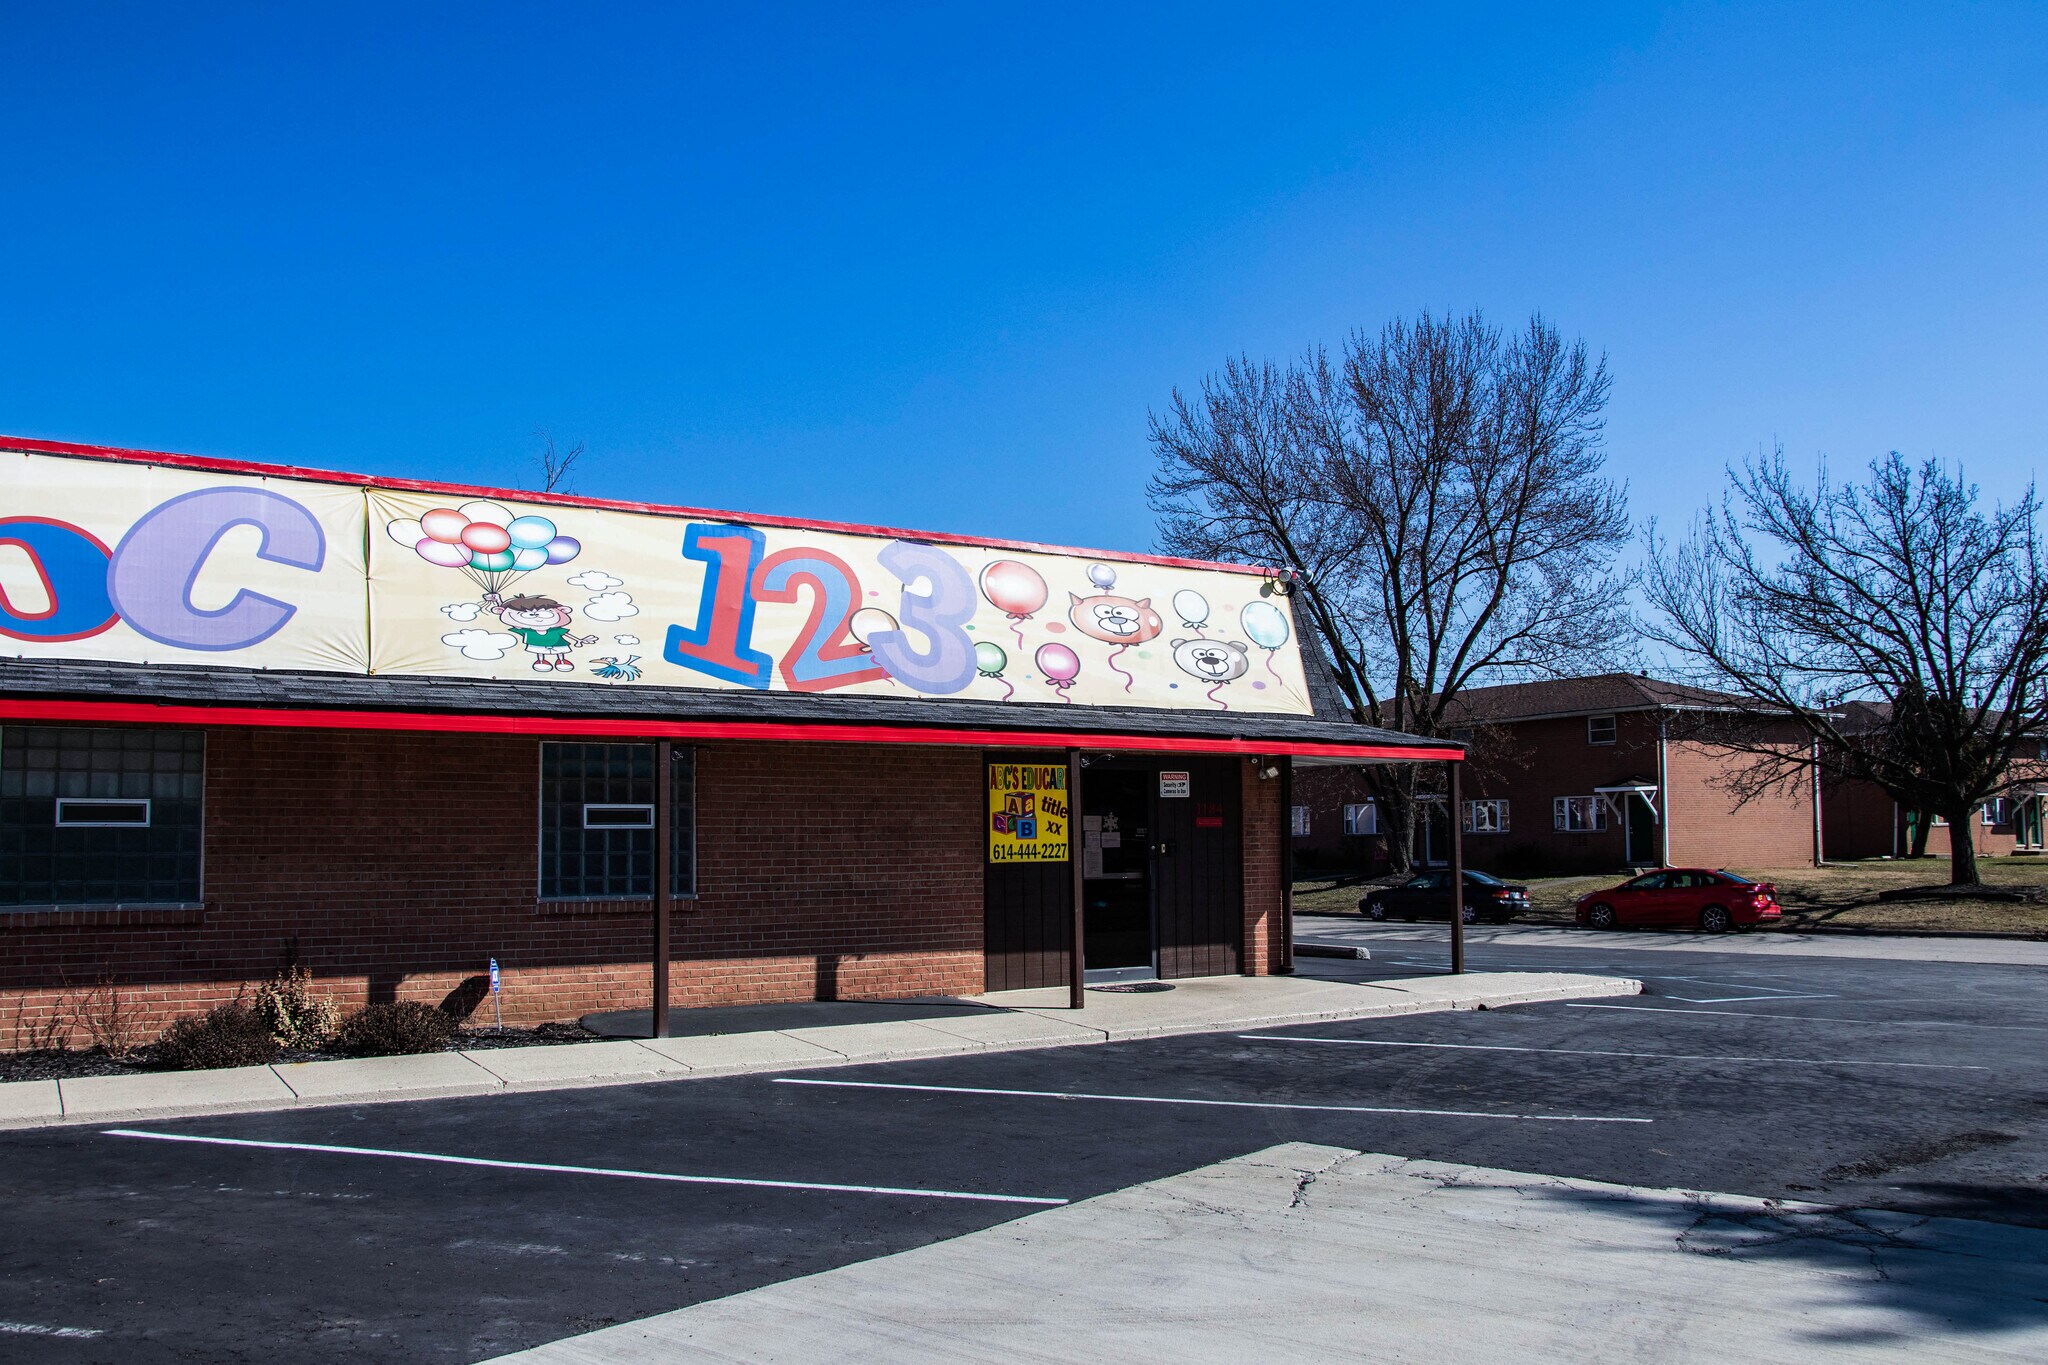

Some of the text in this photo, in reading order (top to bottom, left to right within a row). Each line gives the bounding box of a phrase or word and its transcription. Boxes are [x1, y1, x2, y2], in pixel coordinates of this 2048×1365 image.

[662, 521, 978, 694] 123
[990, 765, 1019, 790] ABC'S
[1008, 798, 1019, 814] A
[1041, 796, 1068, 818] title
[1021, 822, 1032, 836] B
[993, 843, 1067, 860] 614-444-2227
